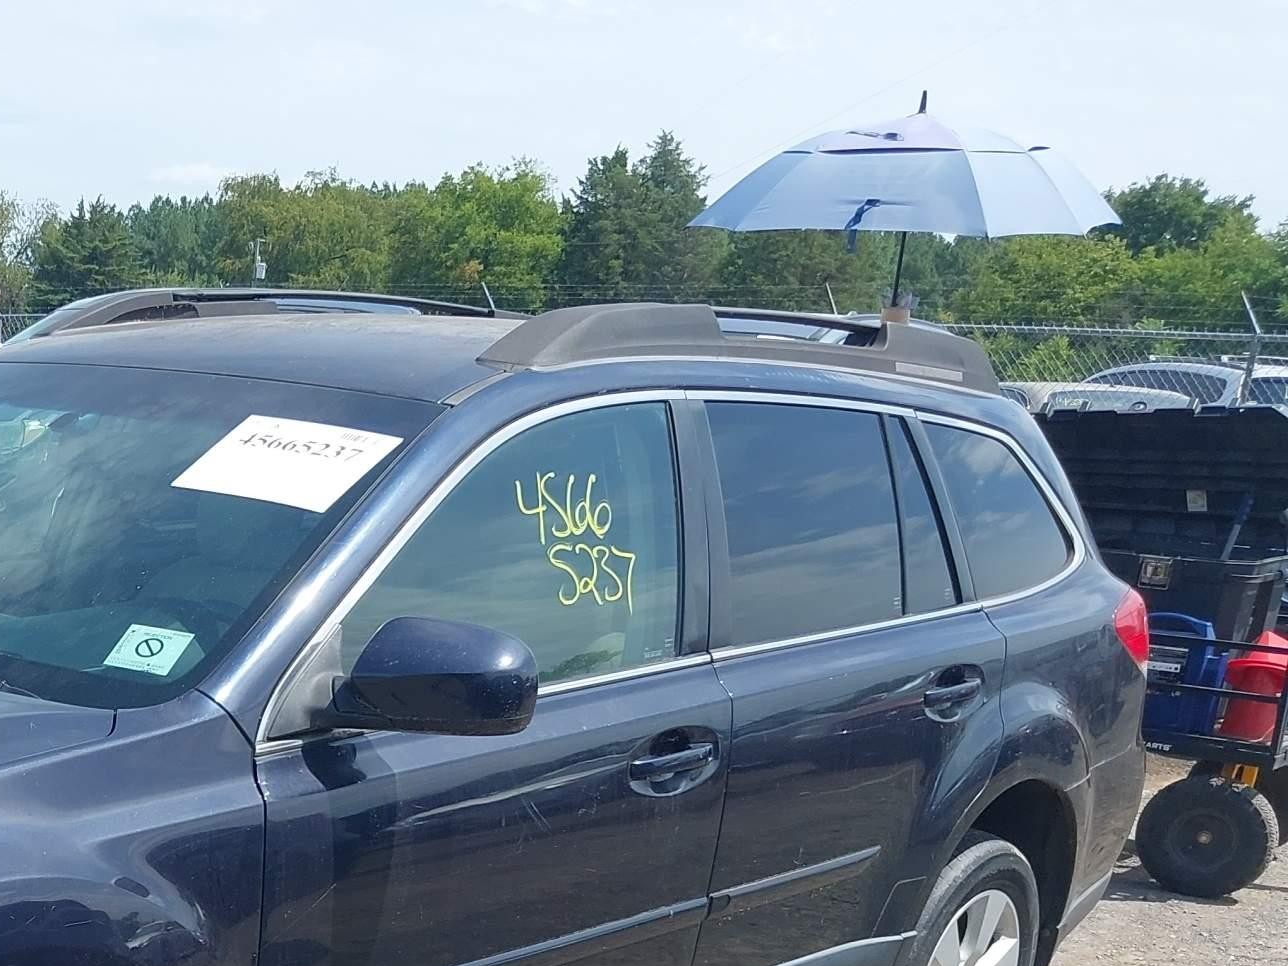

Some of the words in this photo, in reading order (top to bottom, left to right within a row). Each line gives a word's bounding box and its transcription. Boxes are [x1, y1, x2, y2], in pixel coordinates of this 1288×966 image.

[239, 432, 364, 462] 45665237
[514, 470, 612, 545] 4566
[546, 541, 637, 616] 5237
[1143, 741, 1170, 752] ARTS
